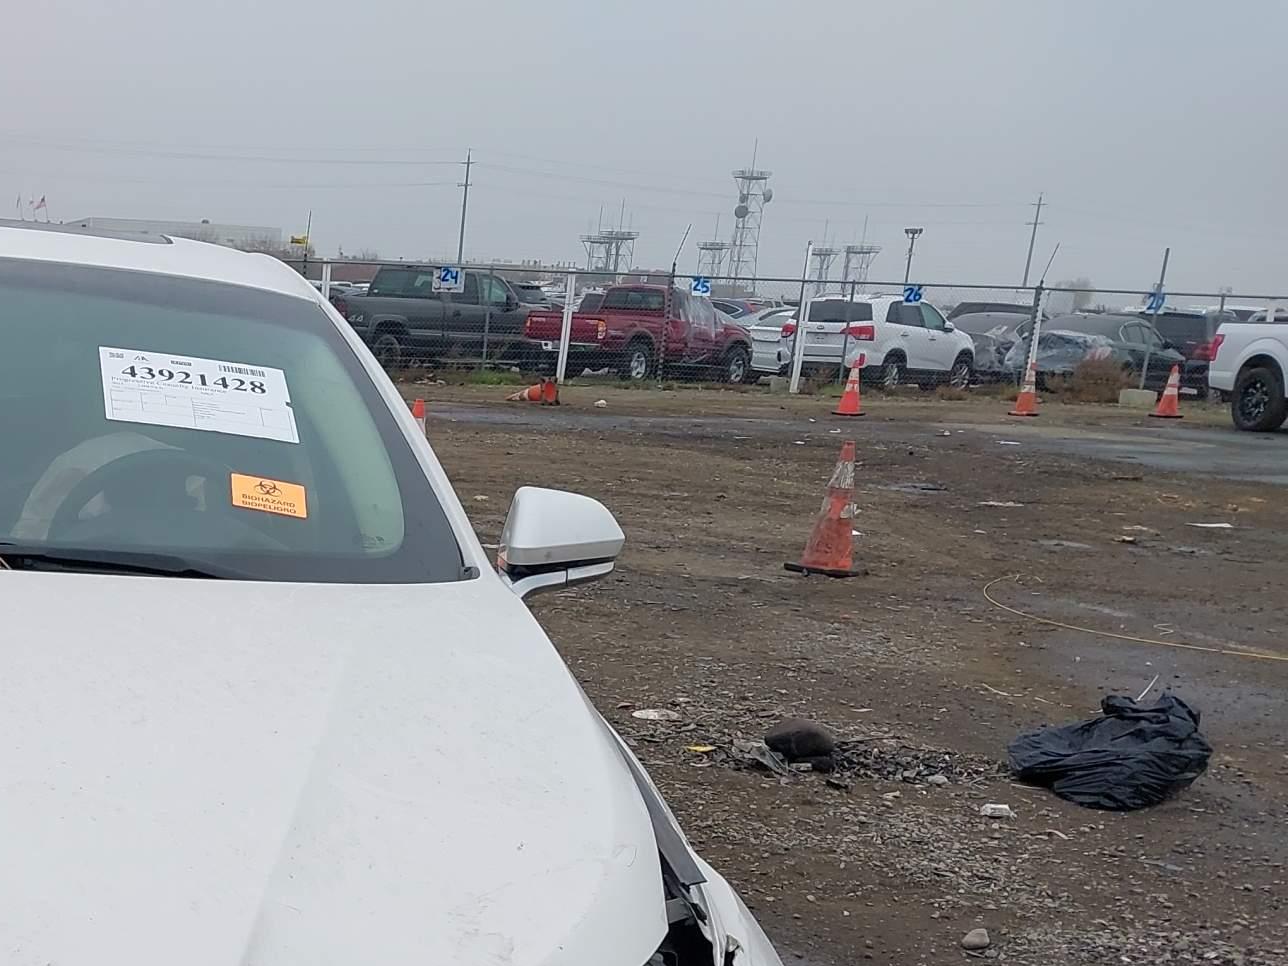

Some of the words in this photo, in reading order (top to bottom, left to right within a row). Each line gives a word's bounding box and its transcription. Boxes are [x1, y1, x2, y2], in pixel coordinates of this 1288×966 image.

[441, 268, 459, 285] 24
[692, 278, 710, 294] 25
[904, 286, 922, 302] 26
[121, 365, 267, 395] 43921428
[242, 493, 296, 508] BIOHAZARD
[242, 500, 297, 514] BIOPELIGRO
